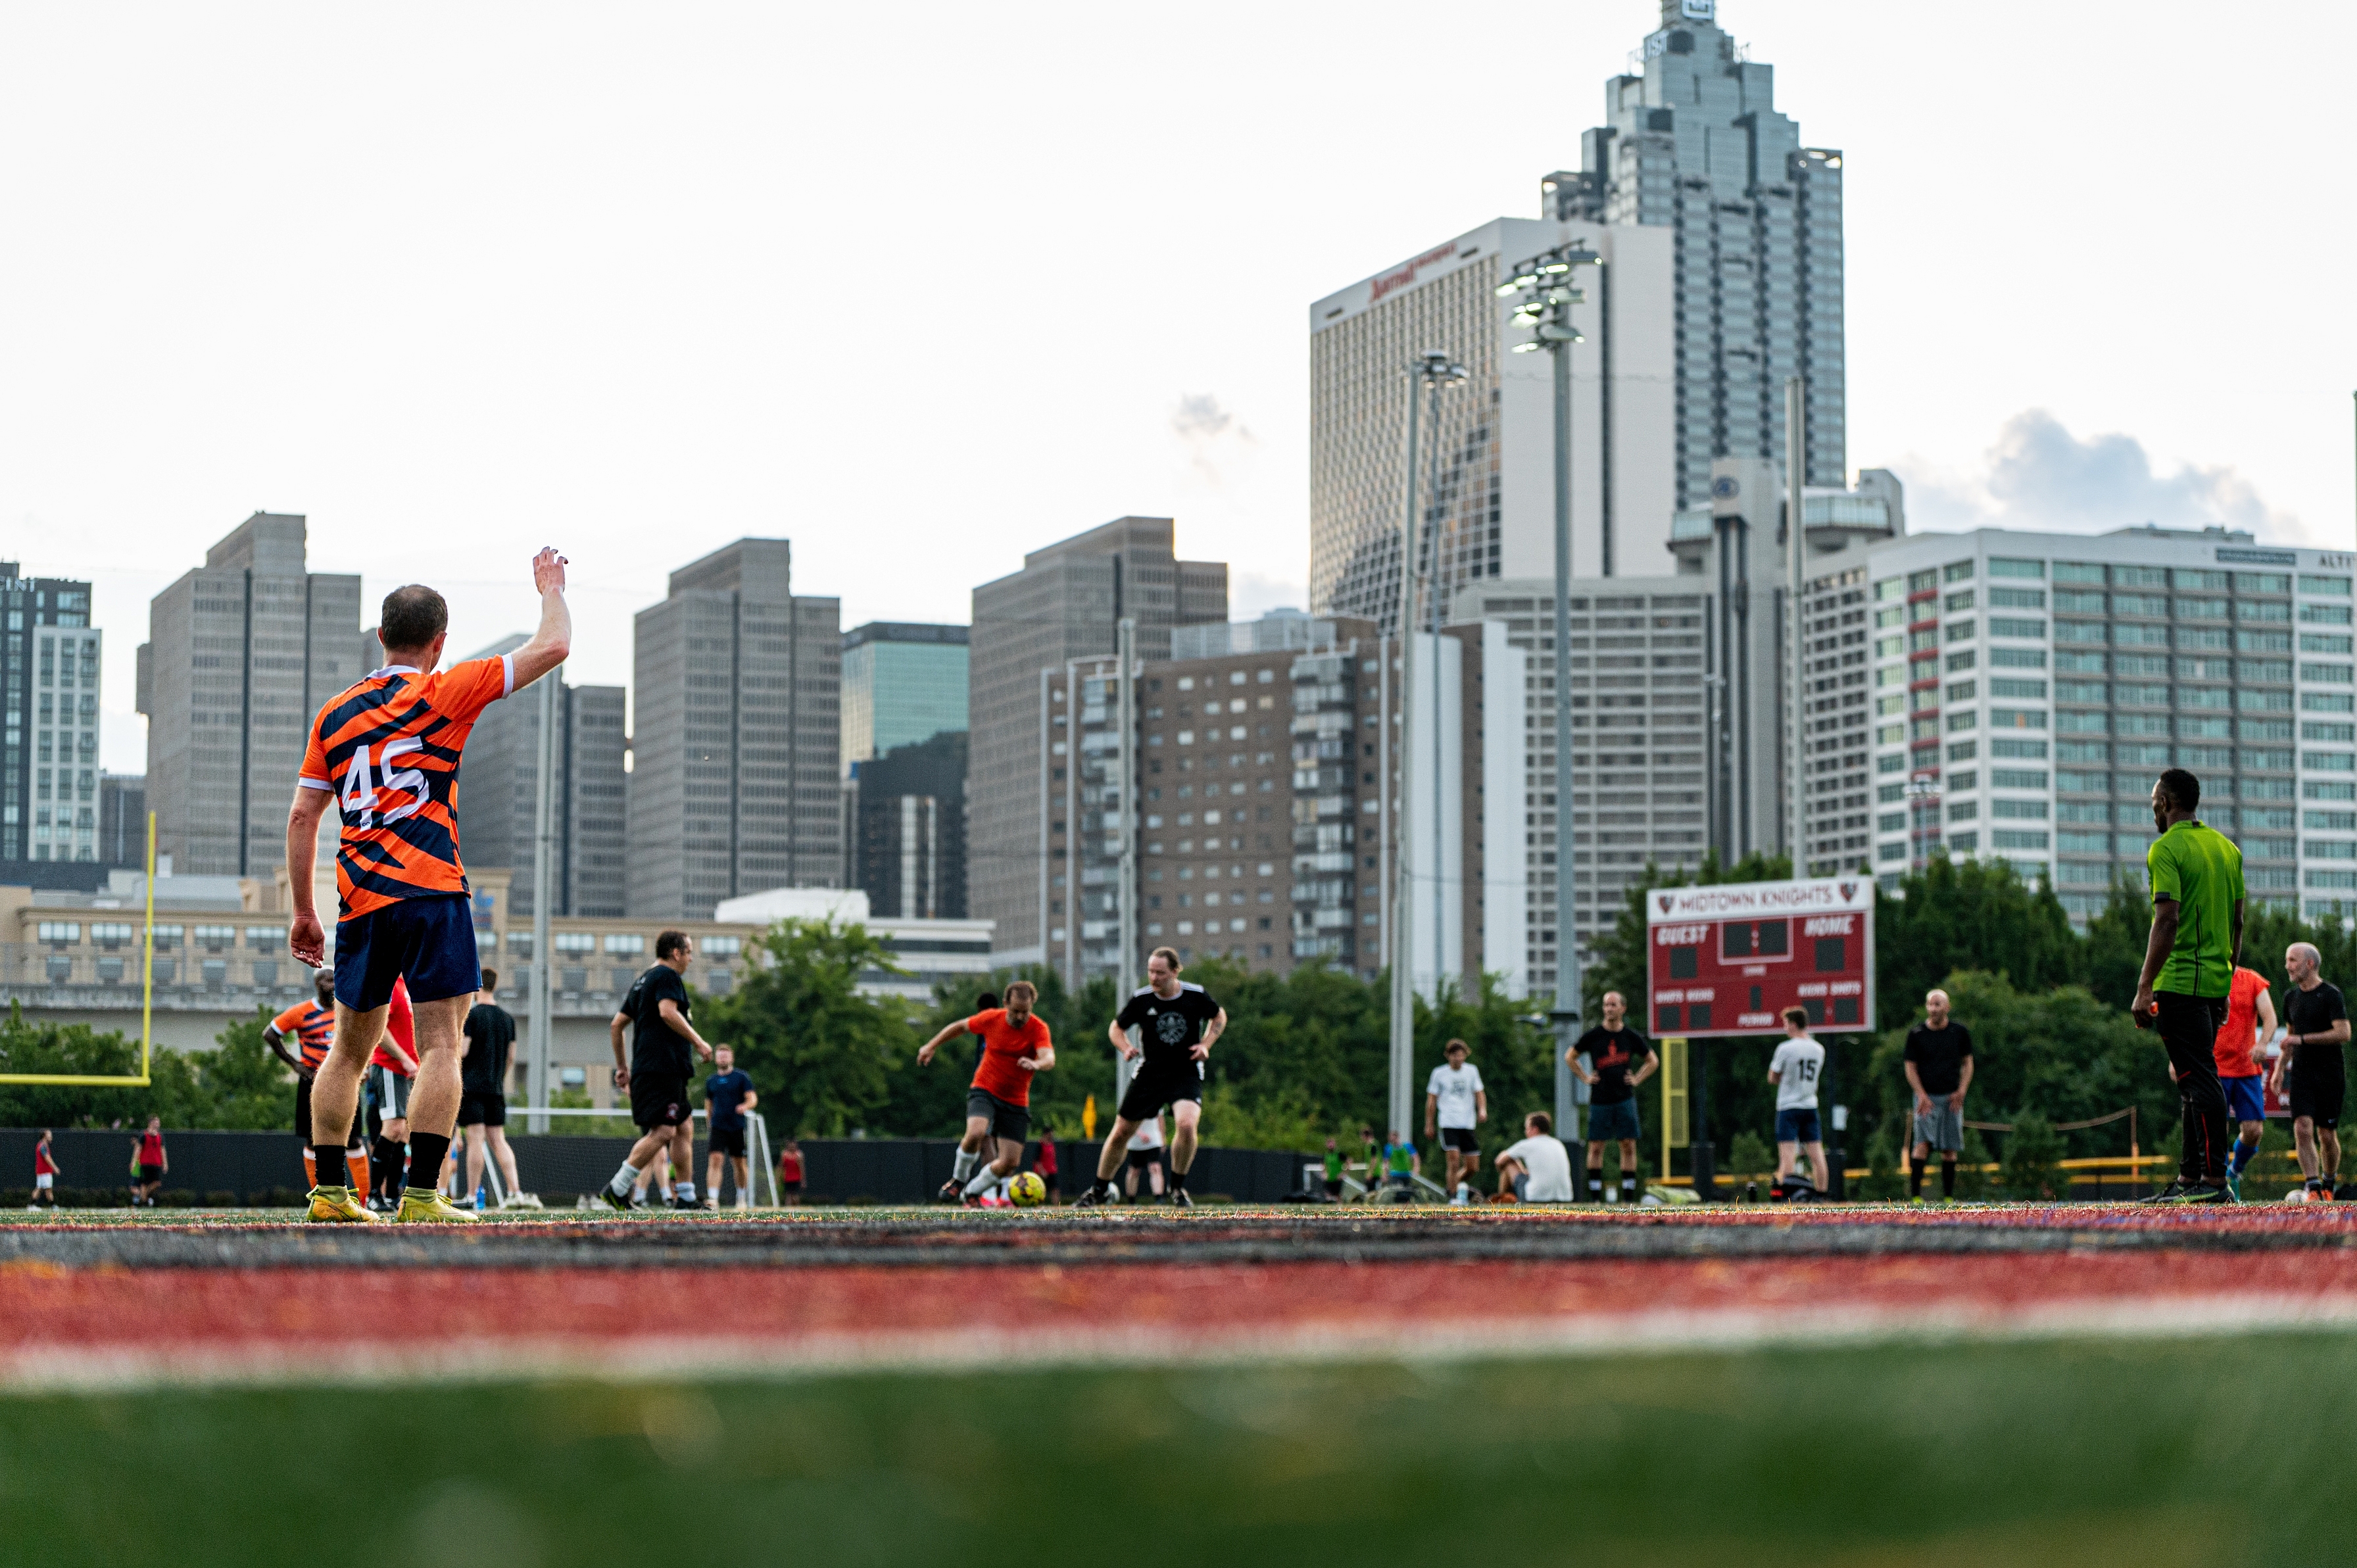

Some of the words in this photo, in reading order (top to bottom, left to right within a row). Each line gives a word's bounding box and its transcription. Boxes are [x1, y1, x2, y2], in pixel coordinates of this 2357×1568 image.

[342, 736, 429, 831] 45
[1679, 893, 1755, 912] MIDTOWN
[1761, 886, 1834, 907] KNIGHTS
[1657, 924, 1709, 945] GUEST
[1804, 915, 1855, 937] HOME
[1799, 1058, 1818, 1081] 15
